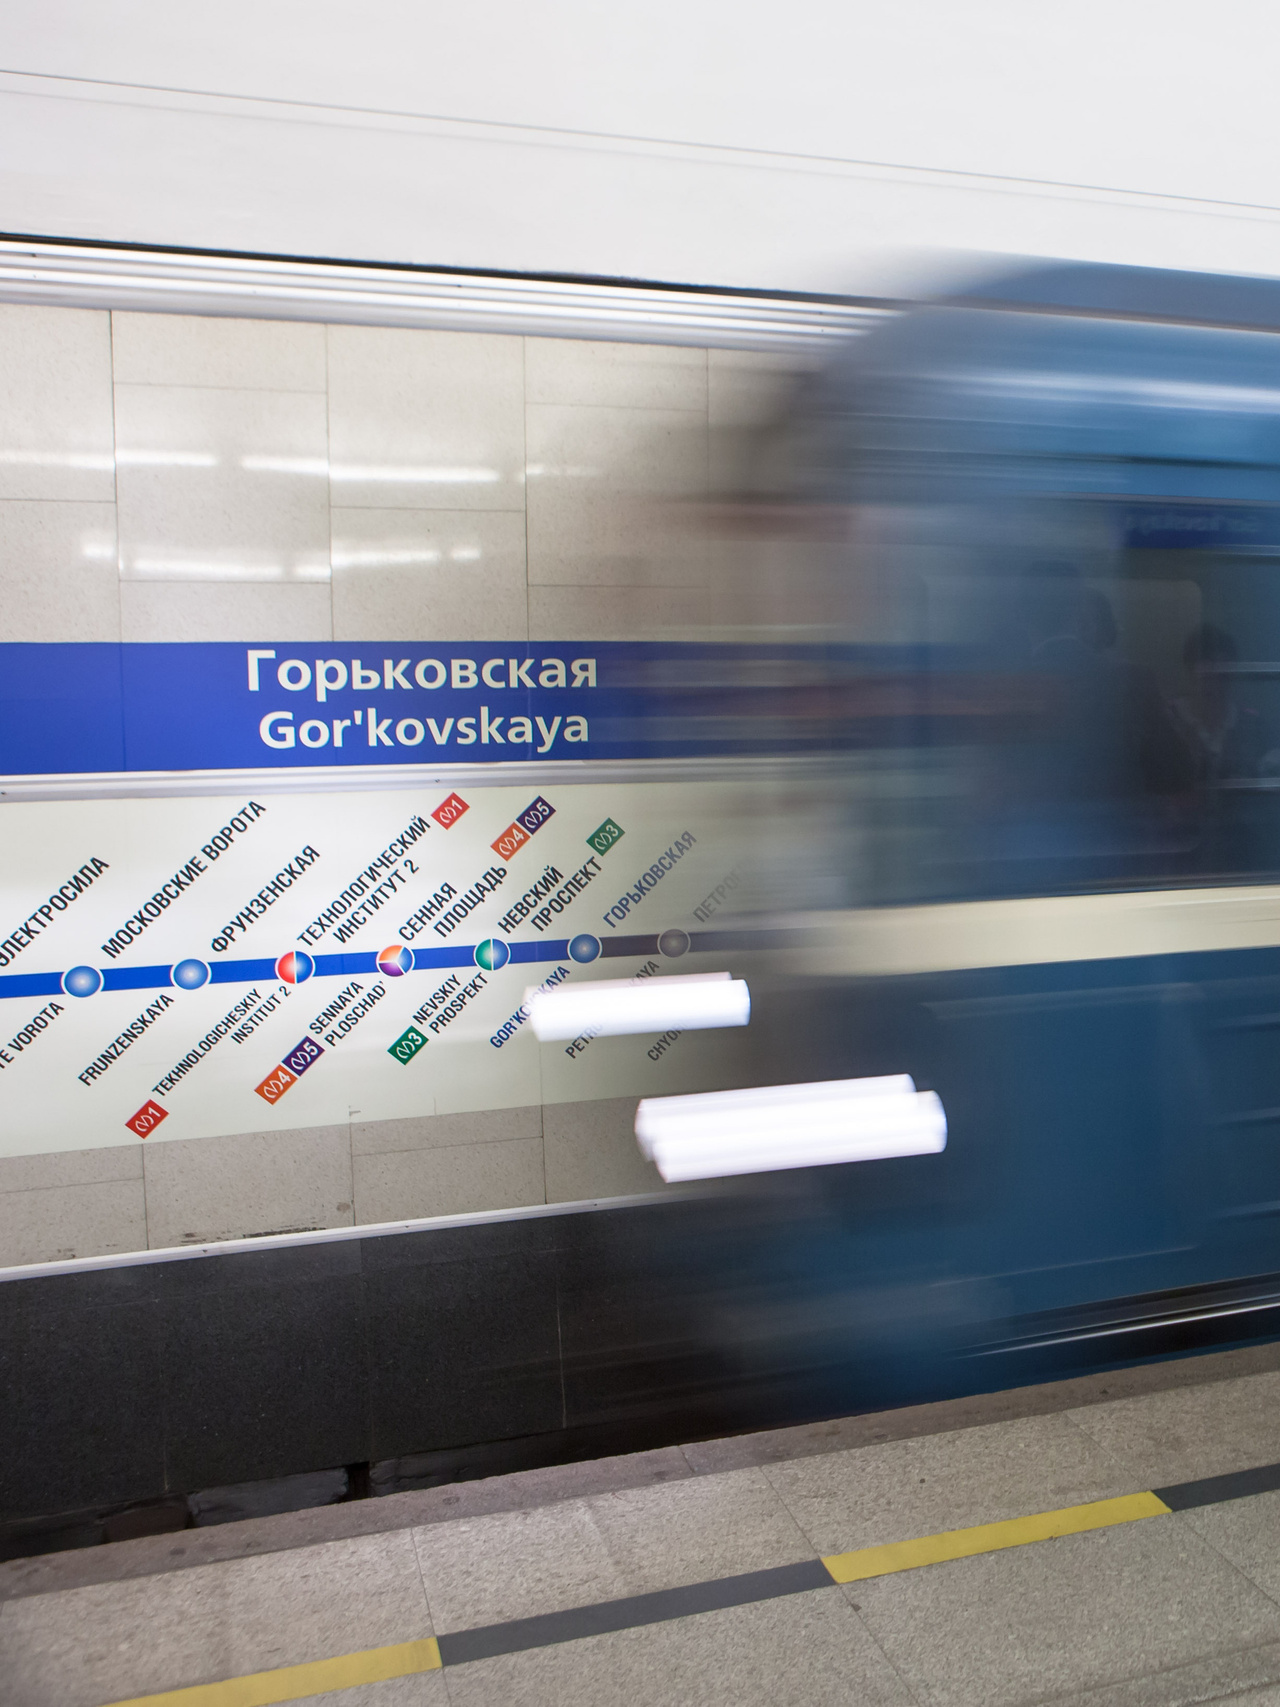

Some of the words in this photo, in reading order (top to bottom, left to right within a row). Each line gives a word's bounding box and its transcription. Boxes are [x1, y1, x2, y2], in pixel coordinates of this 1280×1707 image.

[247, 649, 598, 702] Горьковская
[259, 705, 589, 753] Gor'kovskaya
[101, 856, 208, 959] МОСКОВСКИЕ
[201, 800, 267, 861] ВОРОТА
[210, 845, 321, 953] ФРУНЗЕНСКАЯ
[296, 815, 431, 947] ТЕХНОЛОГИЧЕСКИЙ
[332, 869, 407, 944] ИНСТИТУТ
[403, 859, 420, 874] 2
[398, 882, 458, 942] СЕННАЯ
[433, 866, 508, 938] ПЛОЩАДЬ
[497, 865, 564, 934] НЕВСКИЙ
[530, 856, 602, 932] ПРОСПЕКТ
[603, 830, 698, 929] ГОРЬКОВСКАЯ
[7, 1001, 65, 1052] VOROTA
[230, 993, 283, 1045] INSTITUT
[278, 985, 292, 997] 2
[308, 981, 364, 1035] SENNAYA
[412, 973, 461, 1025] NEVSKIY
[428, 972, 488, 1034] PROSPEKT
[78, 994, 175, 1087] FRUNZENSKAYA
[151, 988, 262, 1097] TEKHNOLOGICHESKIY
